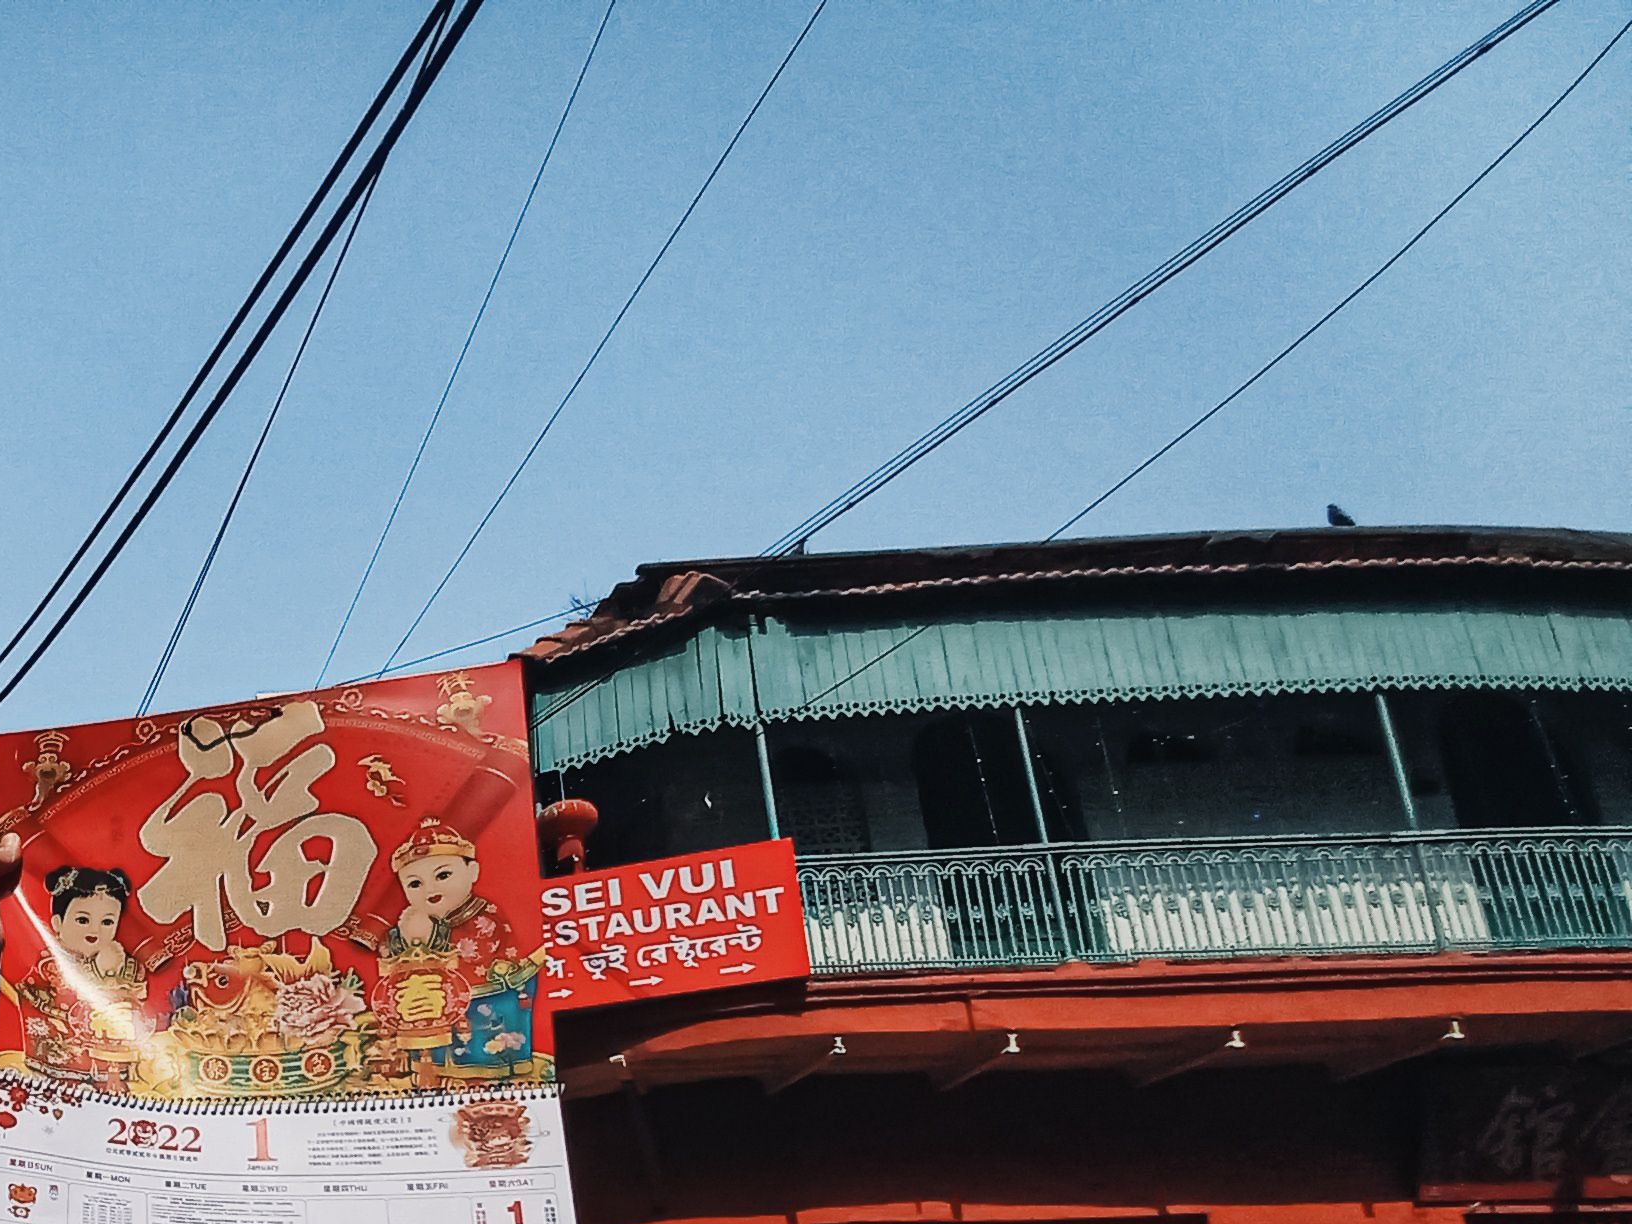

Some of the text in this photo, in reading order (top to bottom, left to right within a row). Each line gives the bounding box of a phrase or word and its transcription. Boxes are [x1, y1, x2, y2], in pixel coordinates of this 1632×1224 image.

[137, 700, 378, 952] 福
[541, 859, 736, 917] SEI VUI
[246, 1118, 278, 1162] 1
